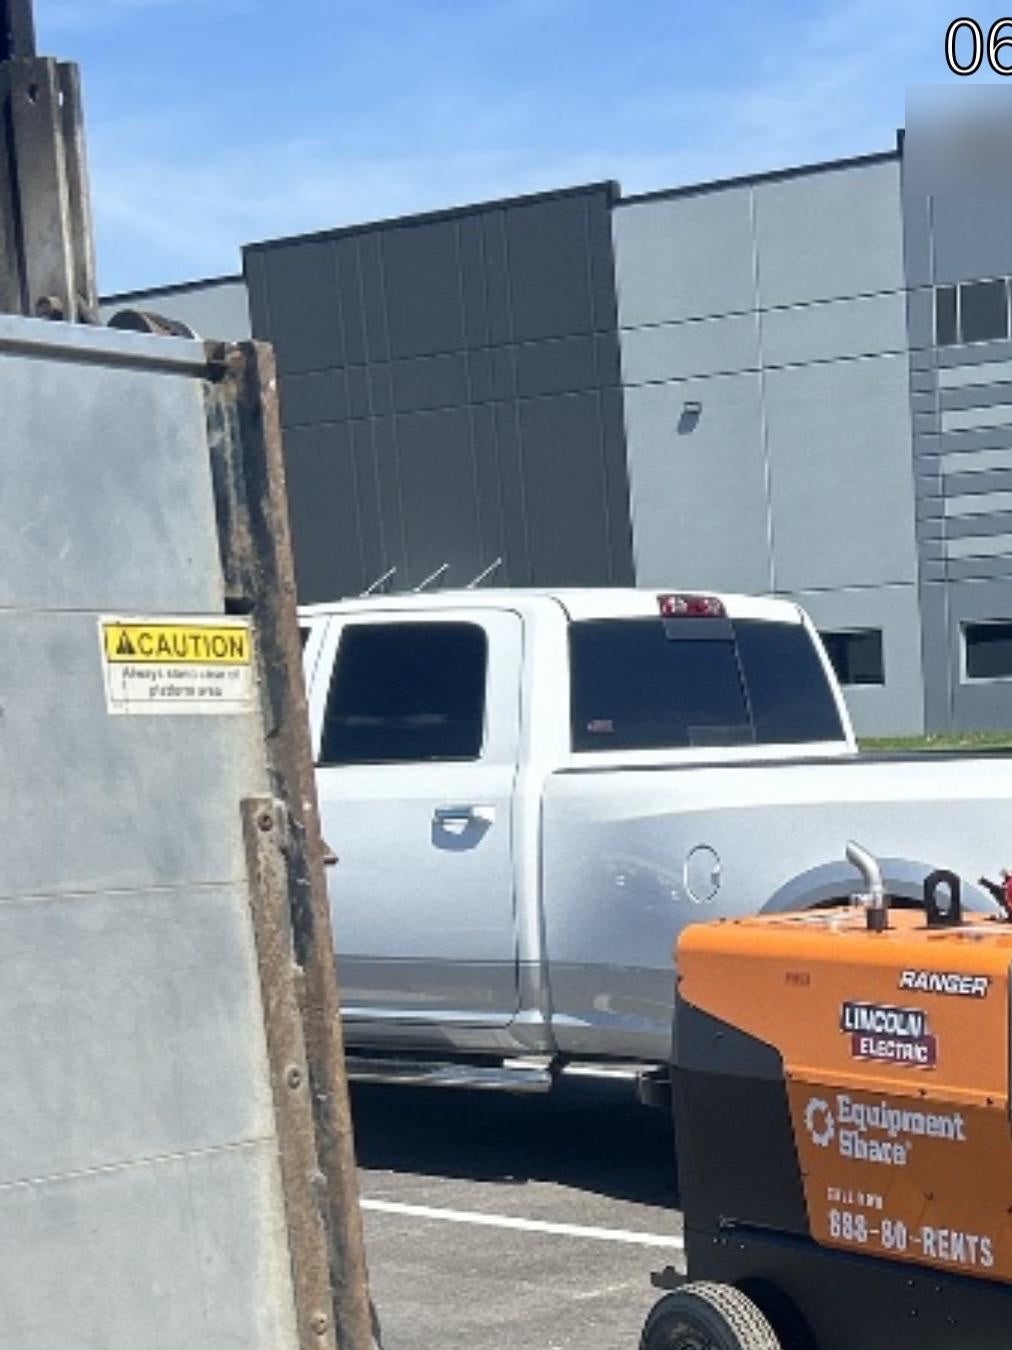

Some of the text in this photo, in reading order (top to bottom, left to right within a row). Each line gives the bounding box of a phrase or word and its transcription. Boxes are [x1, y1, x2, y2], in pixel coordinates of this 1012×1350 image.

[137, 632, 244, 657] CAUTION
[900, 971, 988, 997] RANGER
[844, 1007, 923, 1036] LINCOLN
[859, 1037, 928, 1063] ELECTRIC
[836, 1094, 967, 1141] Equipment
[839, 1131, 907, 1165] Share
